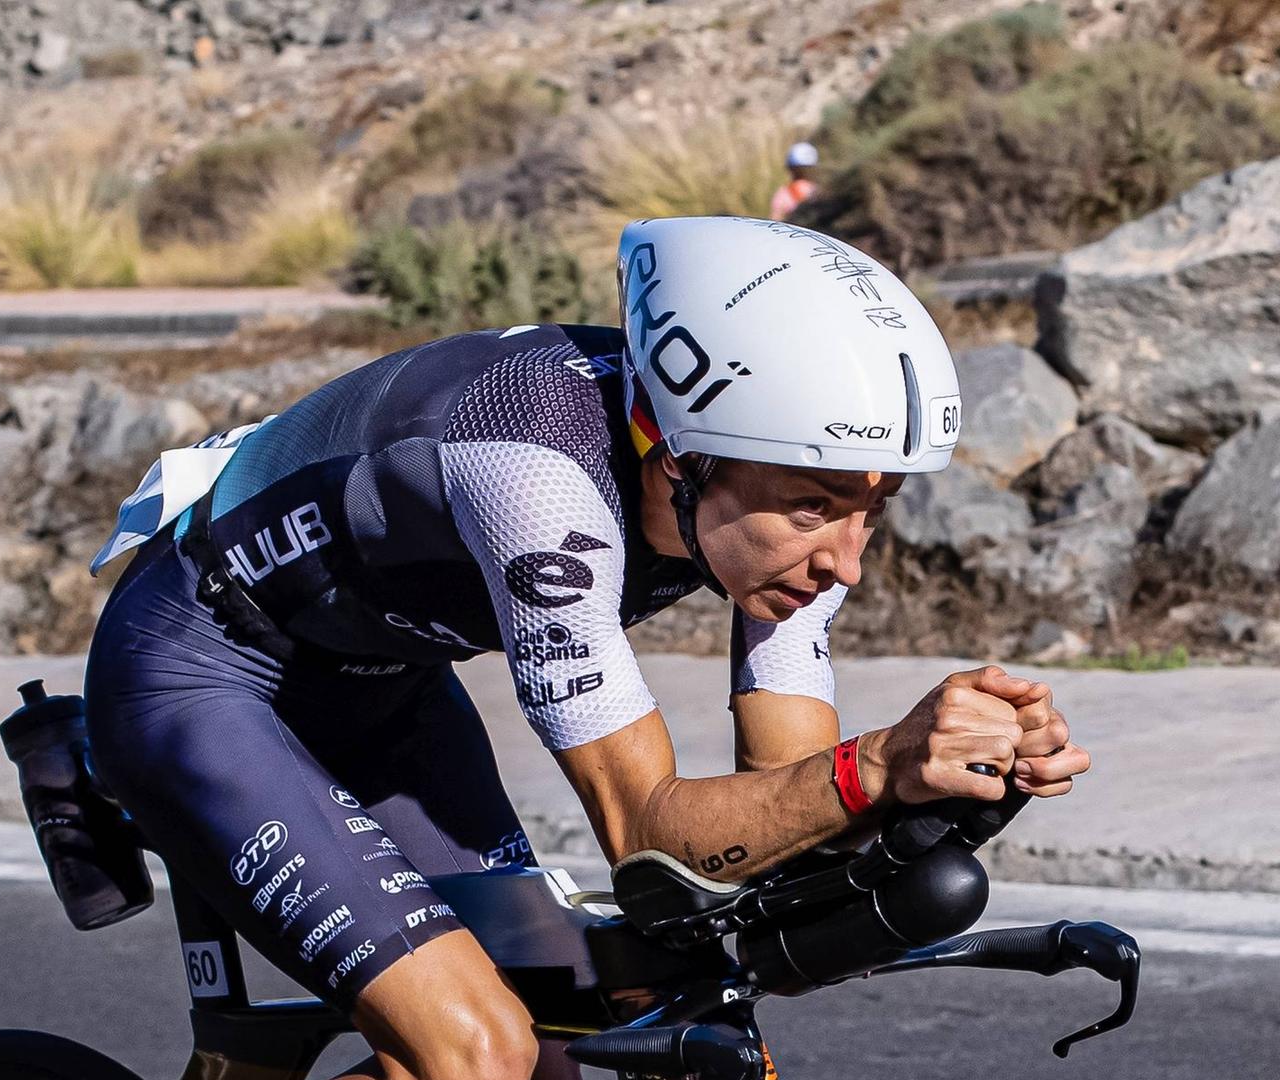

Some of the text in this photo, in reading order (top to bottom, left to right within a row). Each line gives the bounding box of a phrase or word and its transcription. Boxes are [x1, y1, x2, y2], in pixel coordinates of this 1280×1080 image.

[724, 263, 791, 311] AEROZONE
[943, 405, 958, 434] 60
[340, 663, 406, 675] HUUB
[233, 822, 283, 883] PTO
[405, 907, 427, 928] DT
[188, 950, 217, 986] 60
[336, 939, 376, 977] SWISS
